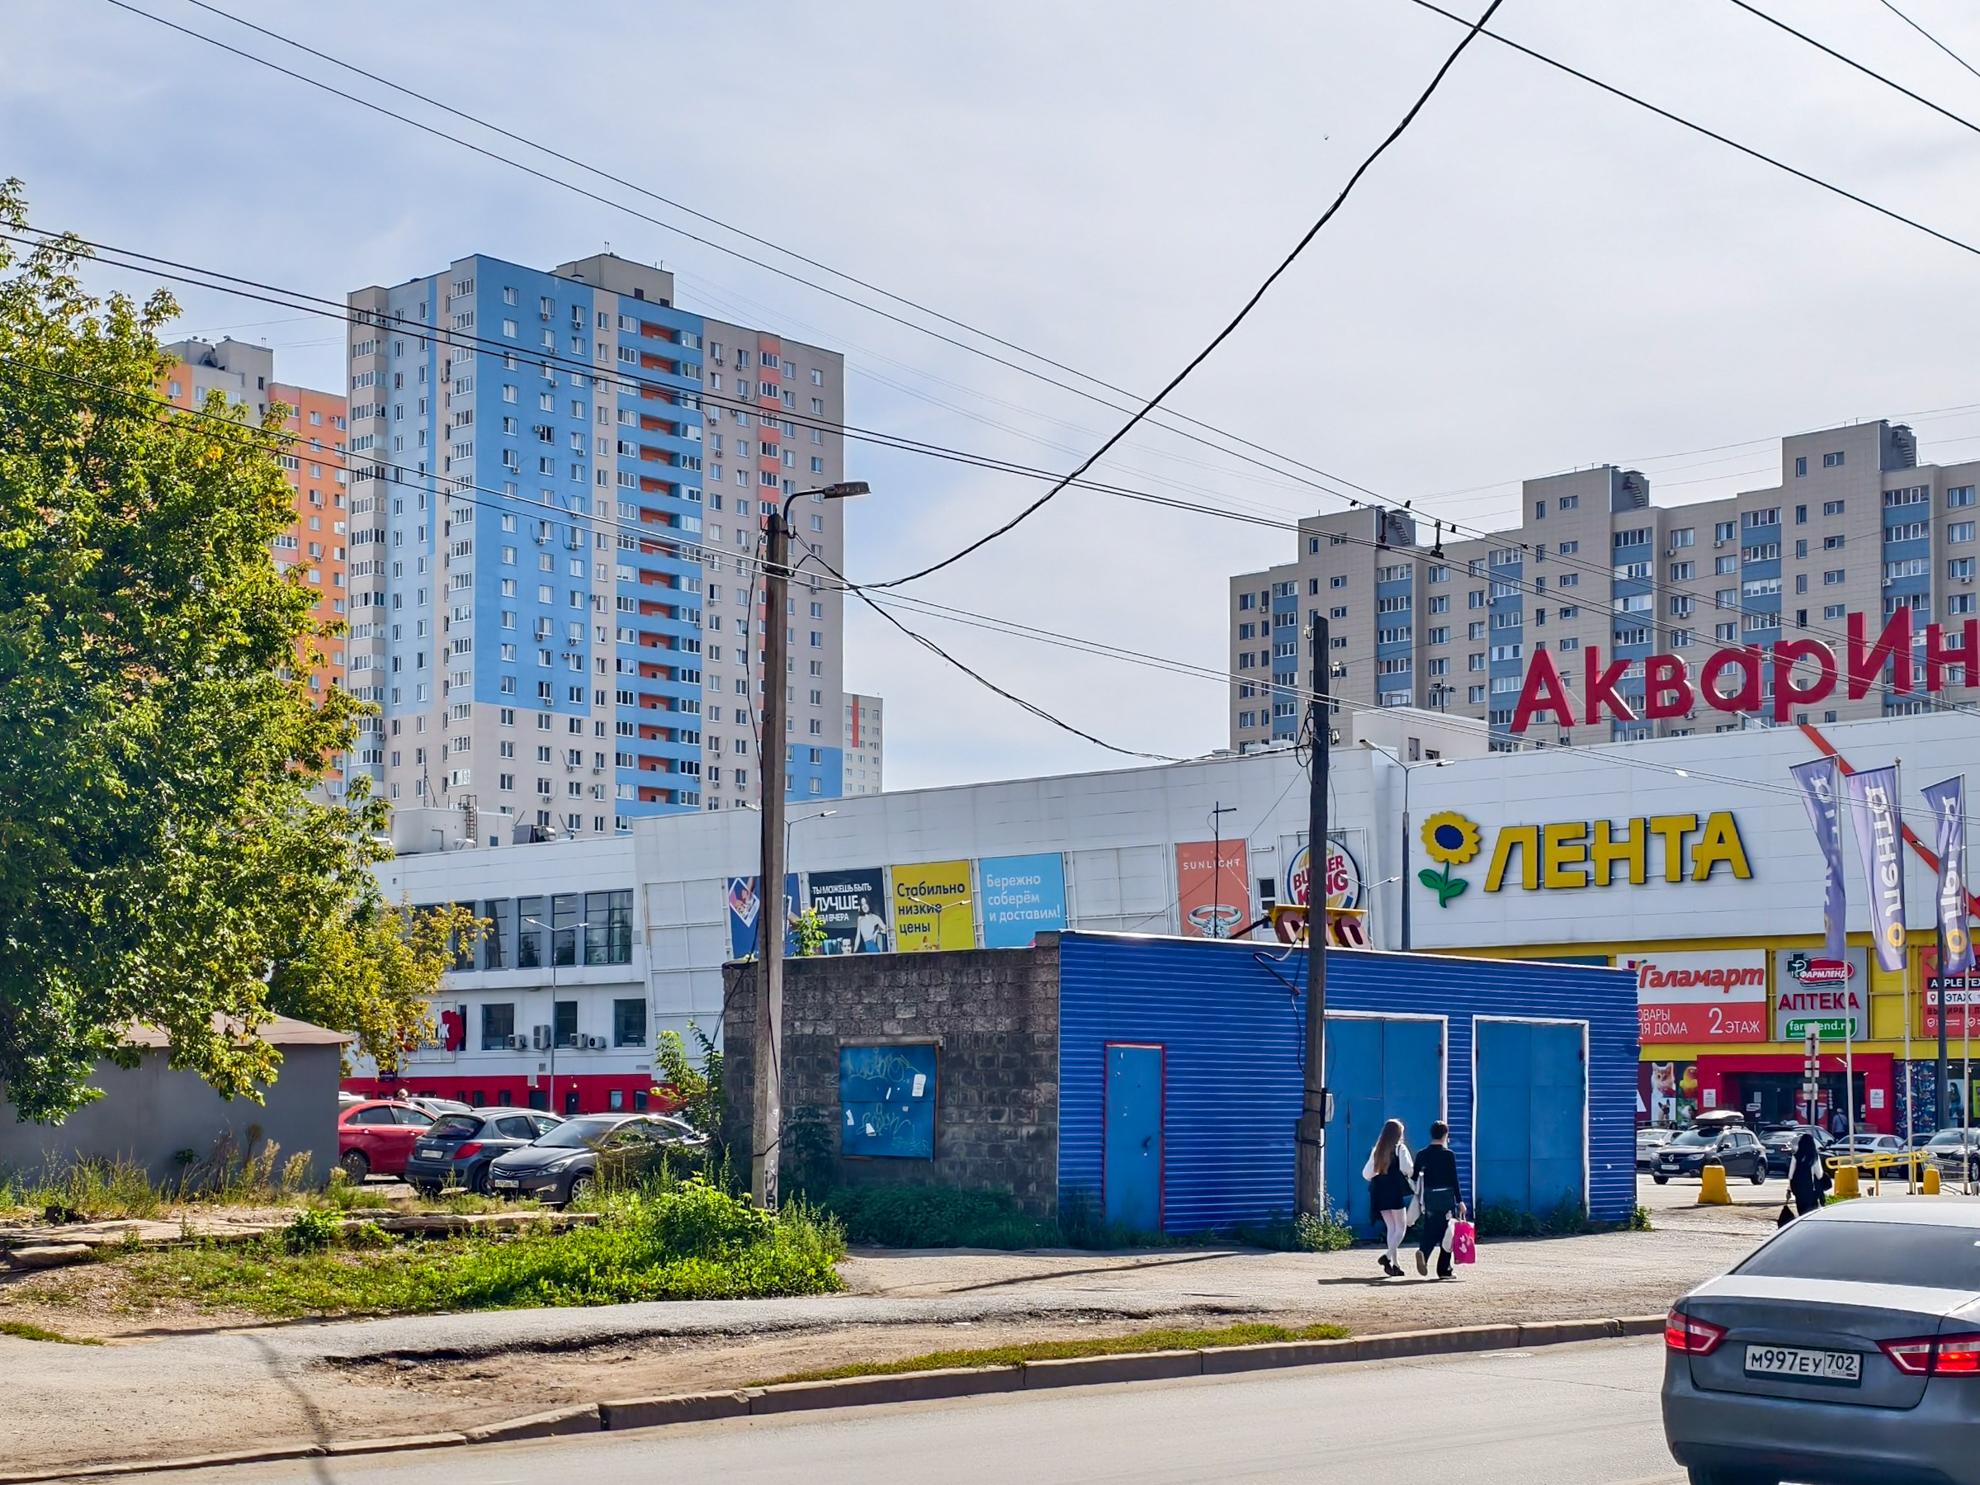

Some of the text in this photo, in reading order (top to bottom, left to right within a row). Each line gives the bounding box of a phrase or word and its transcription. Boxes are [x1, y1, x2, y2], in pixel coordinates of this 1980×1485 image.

[1484, 810, 1752, 893] ЛЕНТА
[1183, 858, 1241, 871] SUNLIGHT
[1293, 854, 1345, 891] BUER
[823, 884, 853, 895] МОЖЕШЬ
[853, 883, 872, 893] БЫТЬ
[897, 881, 966, 898] Стабильно
[986, 873, 1041, 889] Бережно
[815, 895, 861, 913] ЛУЧШЕ,
[988, 890, 1040, 908] соберём
[898, 902, 942, 916] низкие
[989, 904, 1061, 924] и доставим!
[899, 921, 931, 936] цены
[1638, 964, 1765, 994] Галамарт
[1930, 978, 1963, 988] APLE
[1778, 992, 1860, 1011] АПТЕКА
[1637, 1008, 1671, 1022] ОВАРЫ
[1708, 1007, 1761, 1035] 2 ЭТАЖ
[1653, 1021, 1688, 1037] ДОМА
[1827, 1354, 1855, 1371] 702
